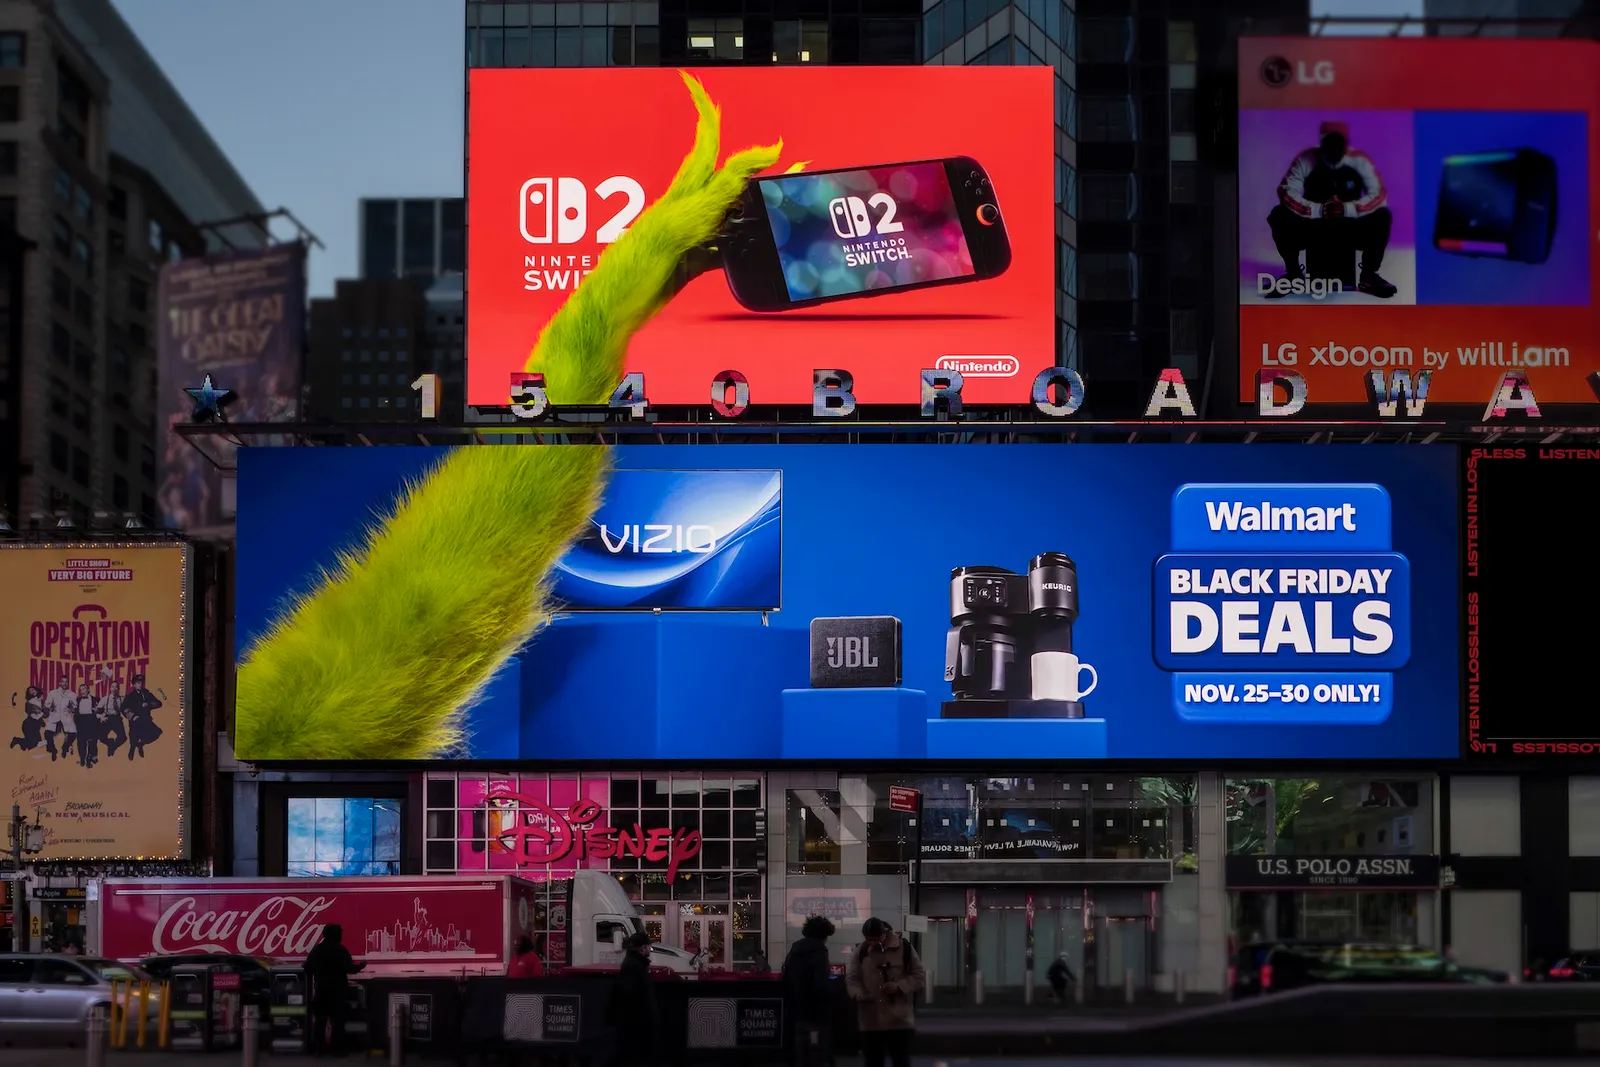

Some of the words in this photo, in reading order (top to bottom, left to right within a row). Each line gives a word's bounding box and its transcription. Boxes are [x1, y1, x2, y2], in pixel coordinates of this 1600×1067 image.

[1298, 62, 1335, 84] LG
[868, 193, 904, 234] 2
[842, 238, 906, 253] NINTENDO
[845, 247, 909, 267] SWITCH
[1257, 272, 1343, 299] Design
[1262, 343, 1298, 366] LG
[1309, 341, 1413, 367] xboom
[1423, 348, 1449, 370] by
[1457, 341, 1570, 367] will.i.am
[812, 366, 1600, 419] BROADWA
[1539, 448, 1600, 459] LISTEN
[1467, 495, 1479, 513] IN
[1205, 502, 1356, 532] Walmart
[600, 524, 716, 553] VIZIO
[1467, 515, 1479, 577] LISTEN
[50, 571, 75, 580] VERY
[76, 571, 94, 580] BIG
[94, 571, 131, 580] FUTURE
[1170, 568, 1274, 594] BLACK
[1278, 568, 1392, 594] FRIDAY
[1041, 582, 1072, 593] KEURIG
[1170, 600, 1394, 655] DEALS
[1467, 591, 1480, 683] LOSSLESS
[30, 621, 150, 662] OPERATION
[826, 636, 879, 669] JBL
[1184, 684, 1240, 703] NOV.
[1313, 684, 1380, 703] ONLY!
[1468, 684, 1480, 703] IN
[29, 787, 60, 802] AGAIN!
[64, 802, 104, 811] BROADWAY
[1257, 859, 1292, 876] U.S.
[1296, 859, 1351, 876] POLO
[1354, 859, 1414, 876] ASSN.
[152, 896, 337, 955] Coca-Cola
[546, 1015, 576, 1024] SQUARE
[548, 1005, 573, 1014] TIMES
[743, 1009, 774, 1018] TIMES
[740, 1019, 778, 1028] SQUARE
